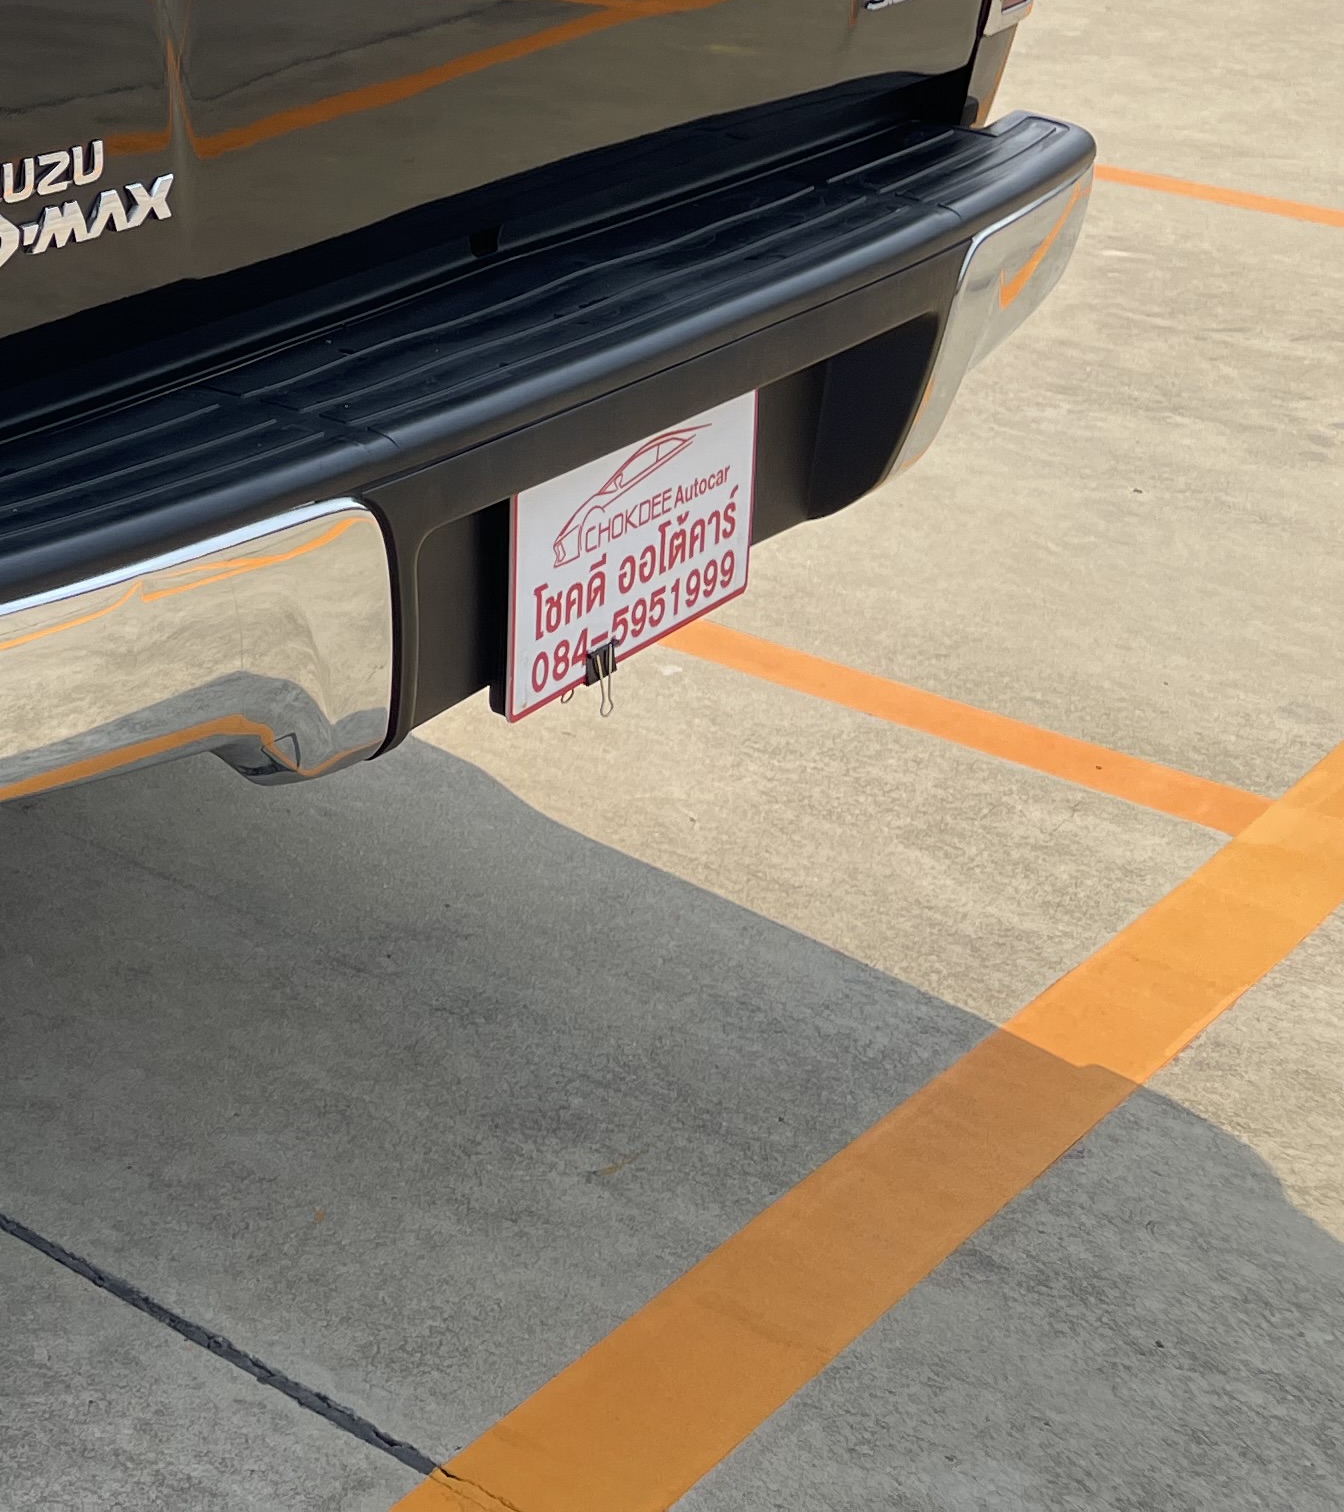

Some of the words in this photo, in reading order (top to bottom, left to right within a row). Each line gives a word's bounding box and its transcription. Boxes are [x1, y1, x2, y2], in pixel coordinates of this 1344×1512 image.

[533, 552, 607, 641] โชคดี
[618, 484, 739, 595] ออโต้คาร์
[585, 488, 673, 553] CHOKDEE
[674, 465, 731, 506] Autocar
[531, 549, 736, 693] 084-5951999
